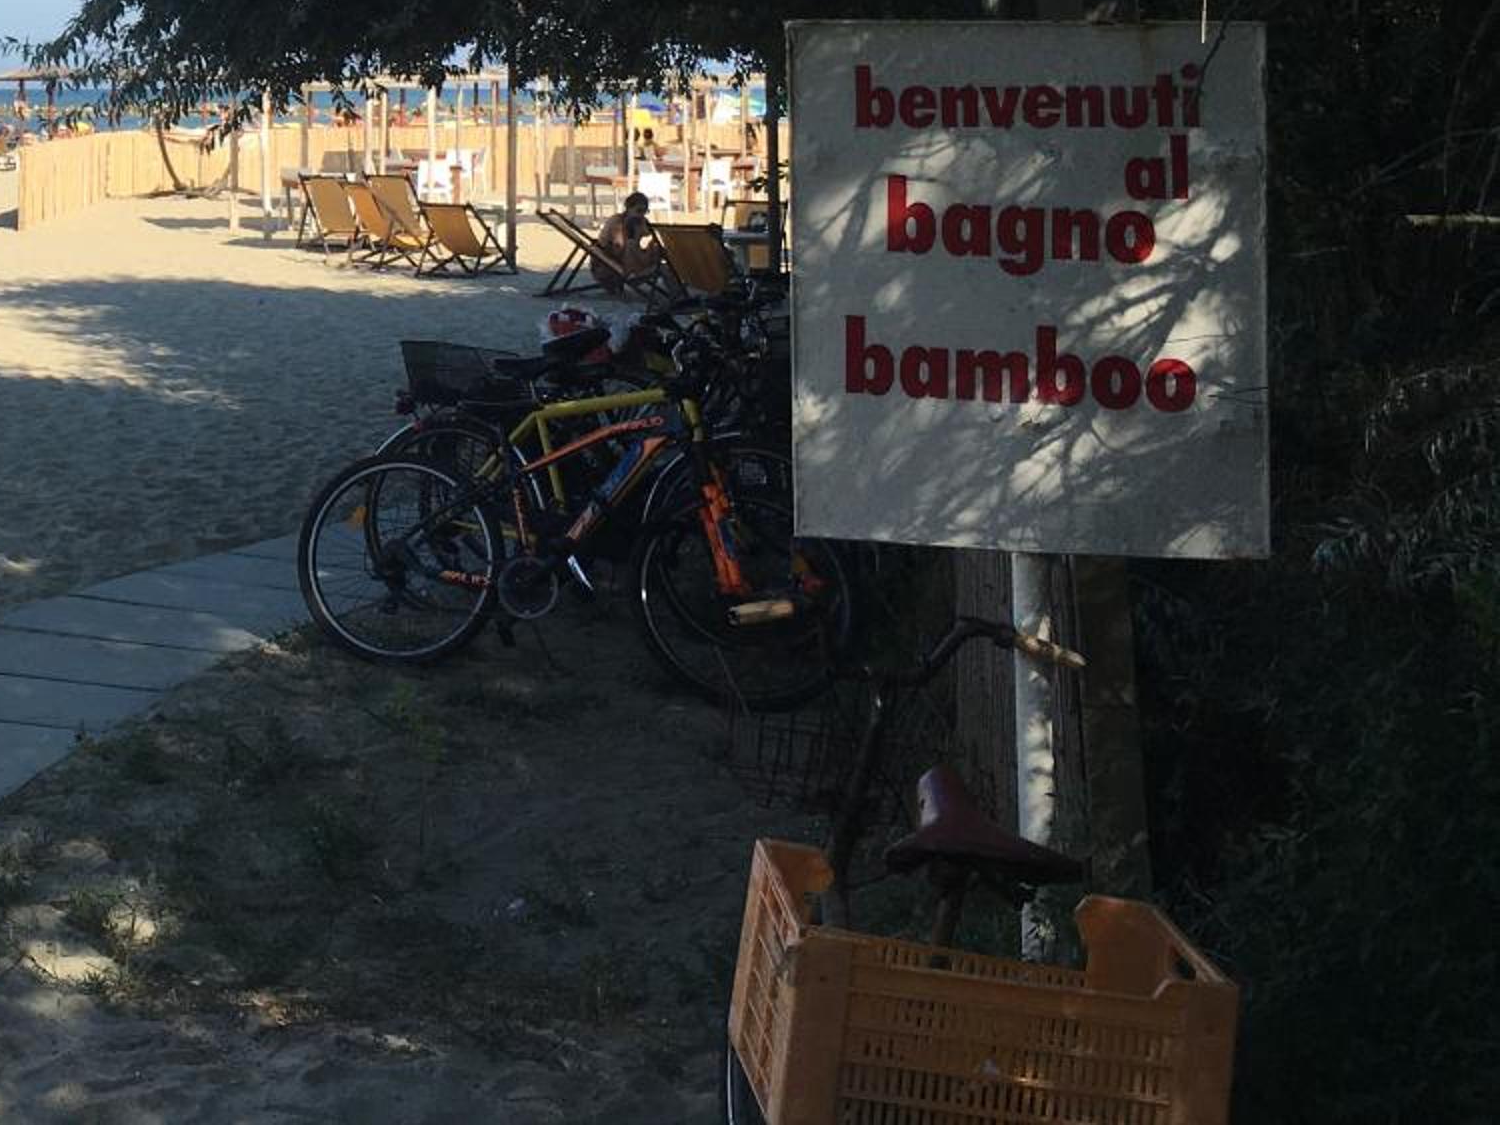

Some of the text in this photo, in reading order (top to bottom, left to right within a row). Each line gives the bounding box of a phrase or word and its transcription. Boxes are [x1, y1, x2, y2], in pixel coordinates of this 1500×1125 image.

[854, 63, 1204, 129] benvenuti
[1124, 134, 1190, 200] al
[886, 174, 1156, 276] bagno
[845, 315, 1197, 413] bamboo
